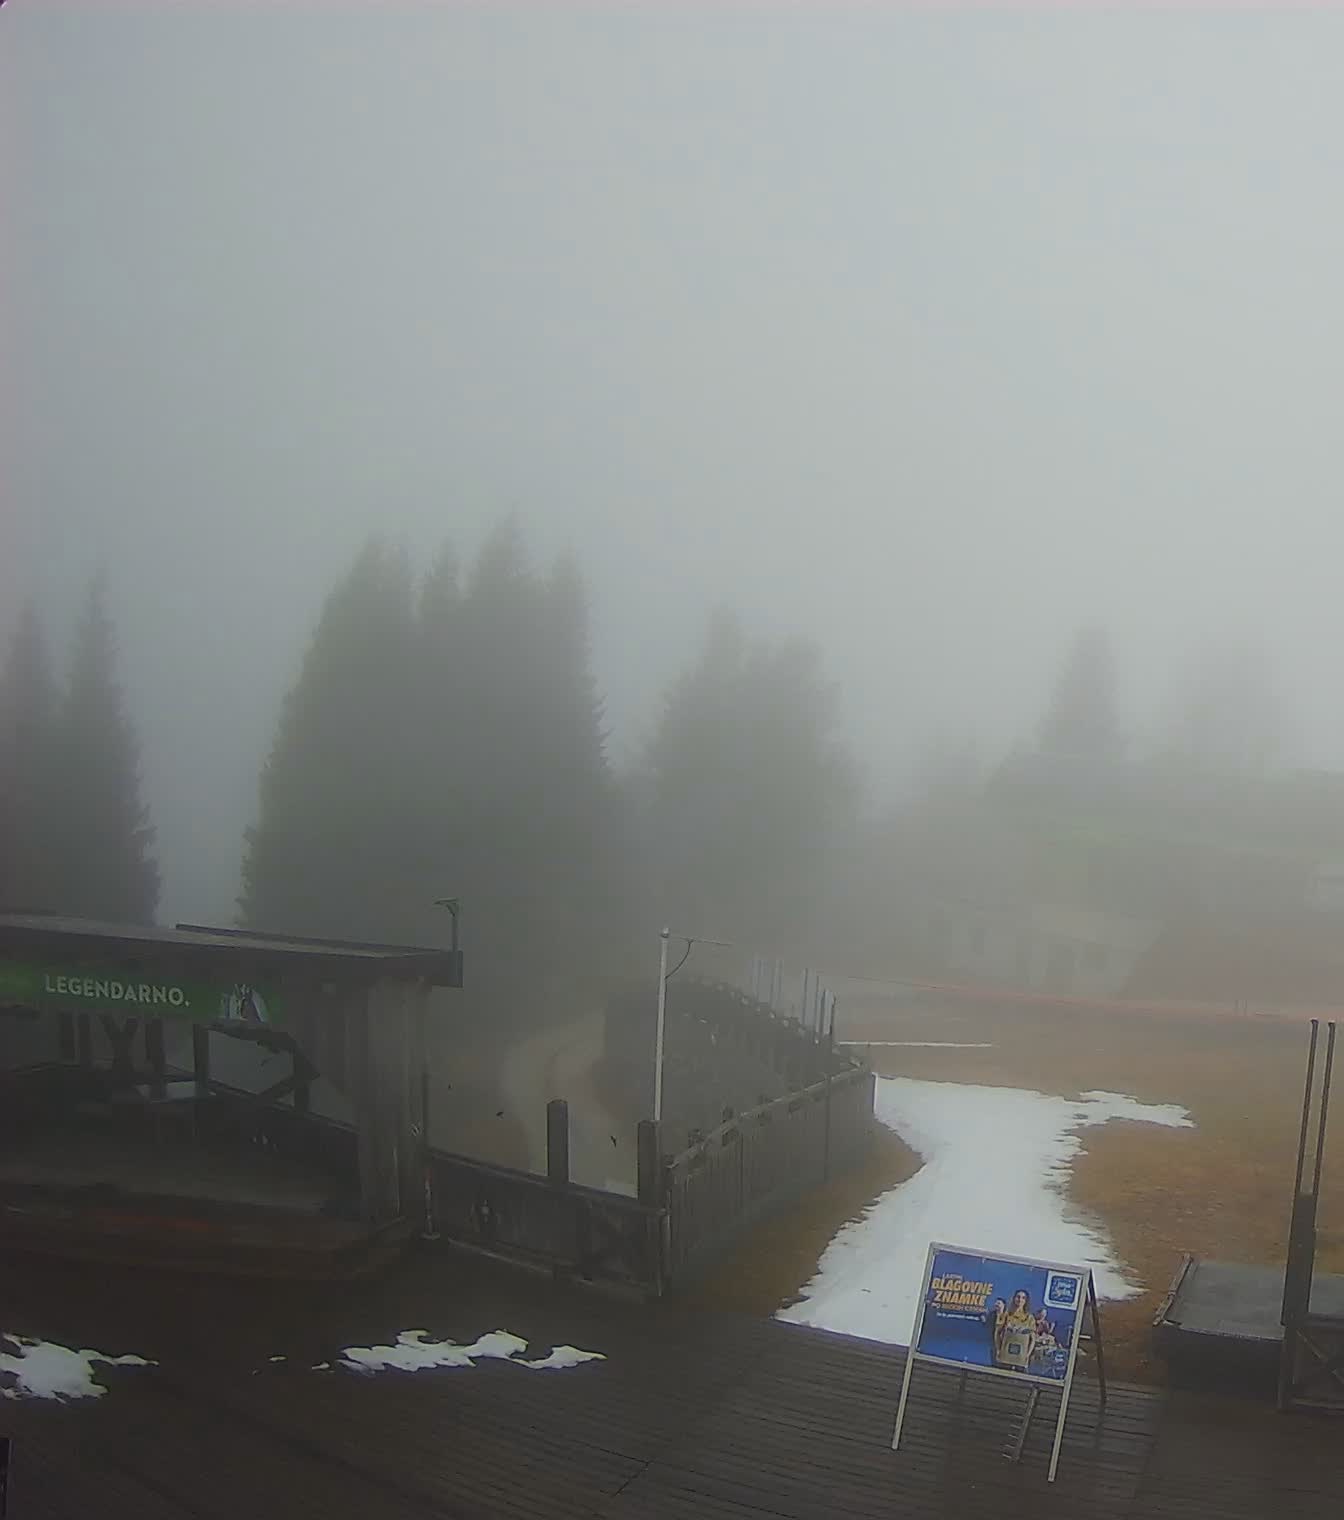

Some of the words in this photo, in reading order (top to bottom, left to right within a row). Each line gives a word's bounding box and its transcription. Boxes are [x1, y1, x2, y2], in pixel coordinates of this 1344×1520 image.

[45, 974, 191, 1007] LEGENDARNO.
[931, 1277, 993, 1295] BLAGOVNE
[934, 1289, 987, 1306] ZNAMKE
